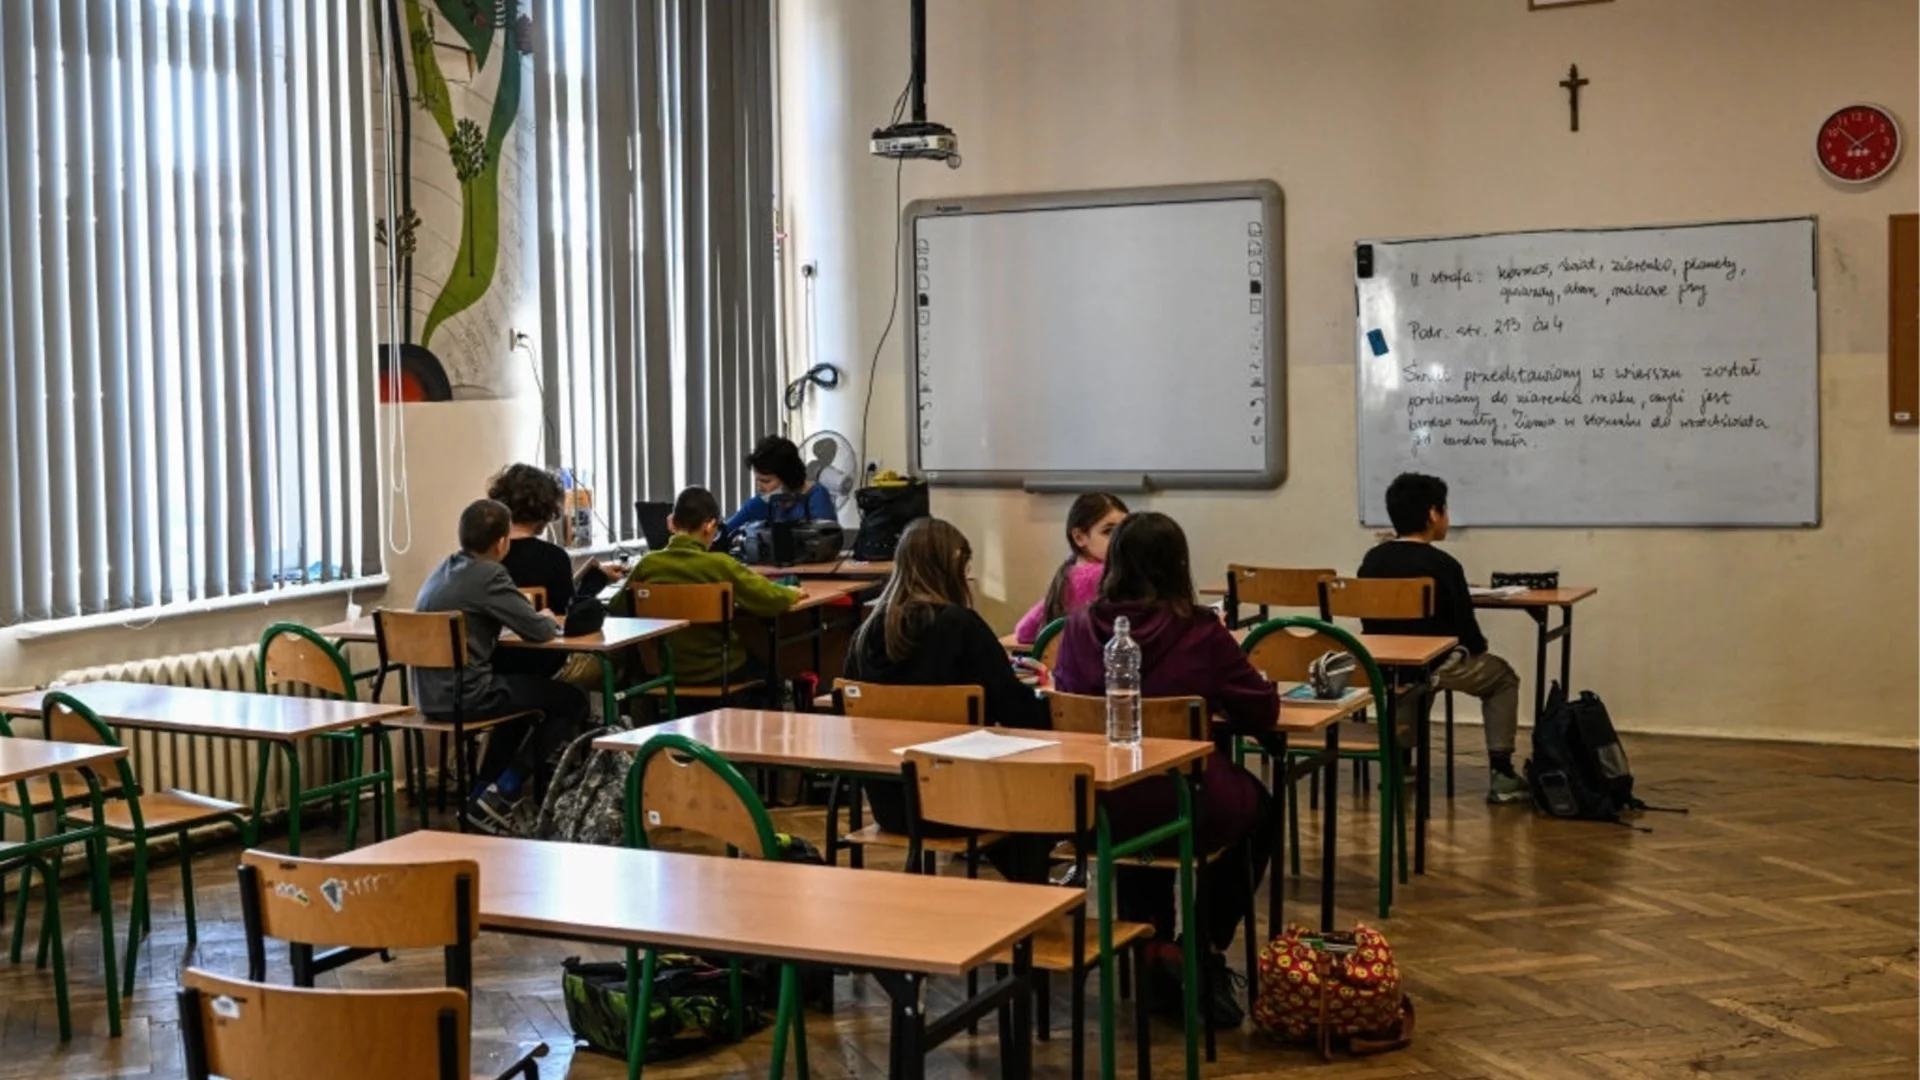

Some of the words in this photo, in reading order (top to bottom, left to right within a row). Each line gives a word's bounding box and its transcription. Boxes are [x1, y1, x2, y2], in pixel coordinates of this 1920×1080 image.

[1494, 316, 1521, 334] 213
[1553, 313, 1563, 333] 4
[1402, 358, 1451, 382] Świ
[1490, 390, 1508, 404] do
[1700, 387, 1732, 416] jest
